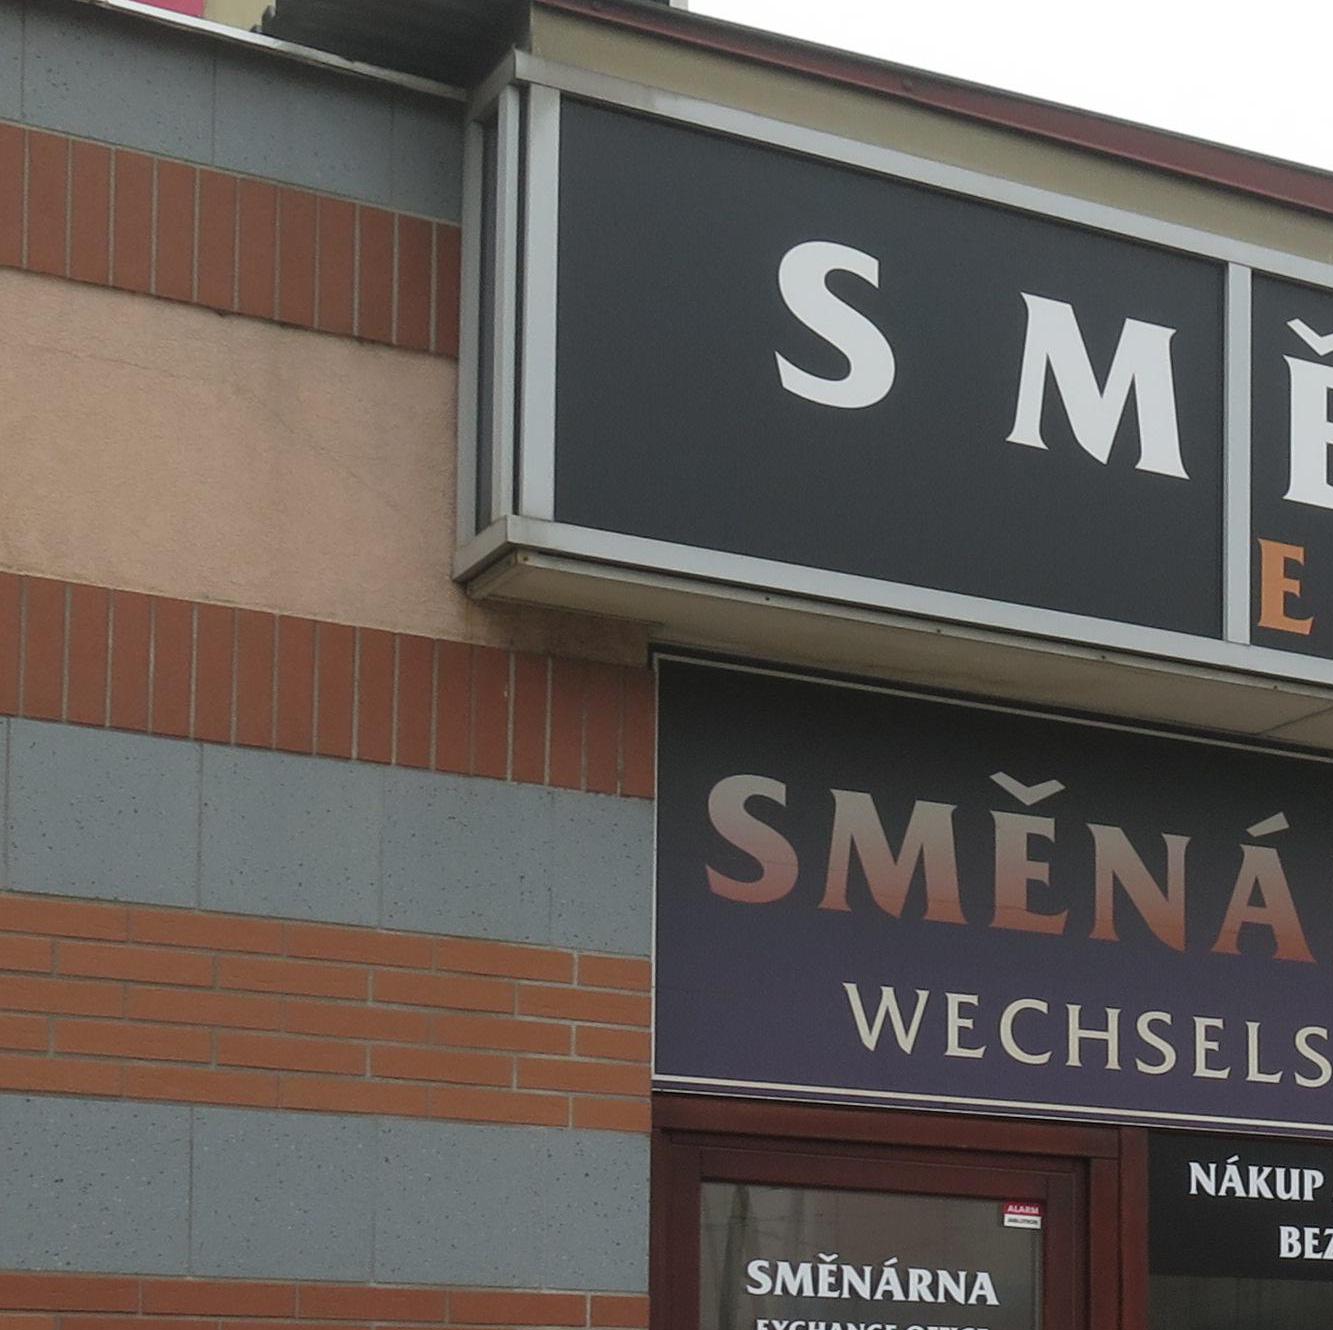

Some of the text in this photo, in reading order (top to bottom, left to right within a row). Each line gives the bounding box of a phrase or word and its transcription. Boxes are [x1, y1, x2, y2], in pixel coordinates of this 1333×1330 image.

[1190, 1156, 1323, 1200] NÁKUP
[1007, 1204, 1040, 1215] ALARM
[746, 1253, 999, 1305] SMĚNÁRNA
